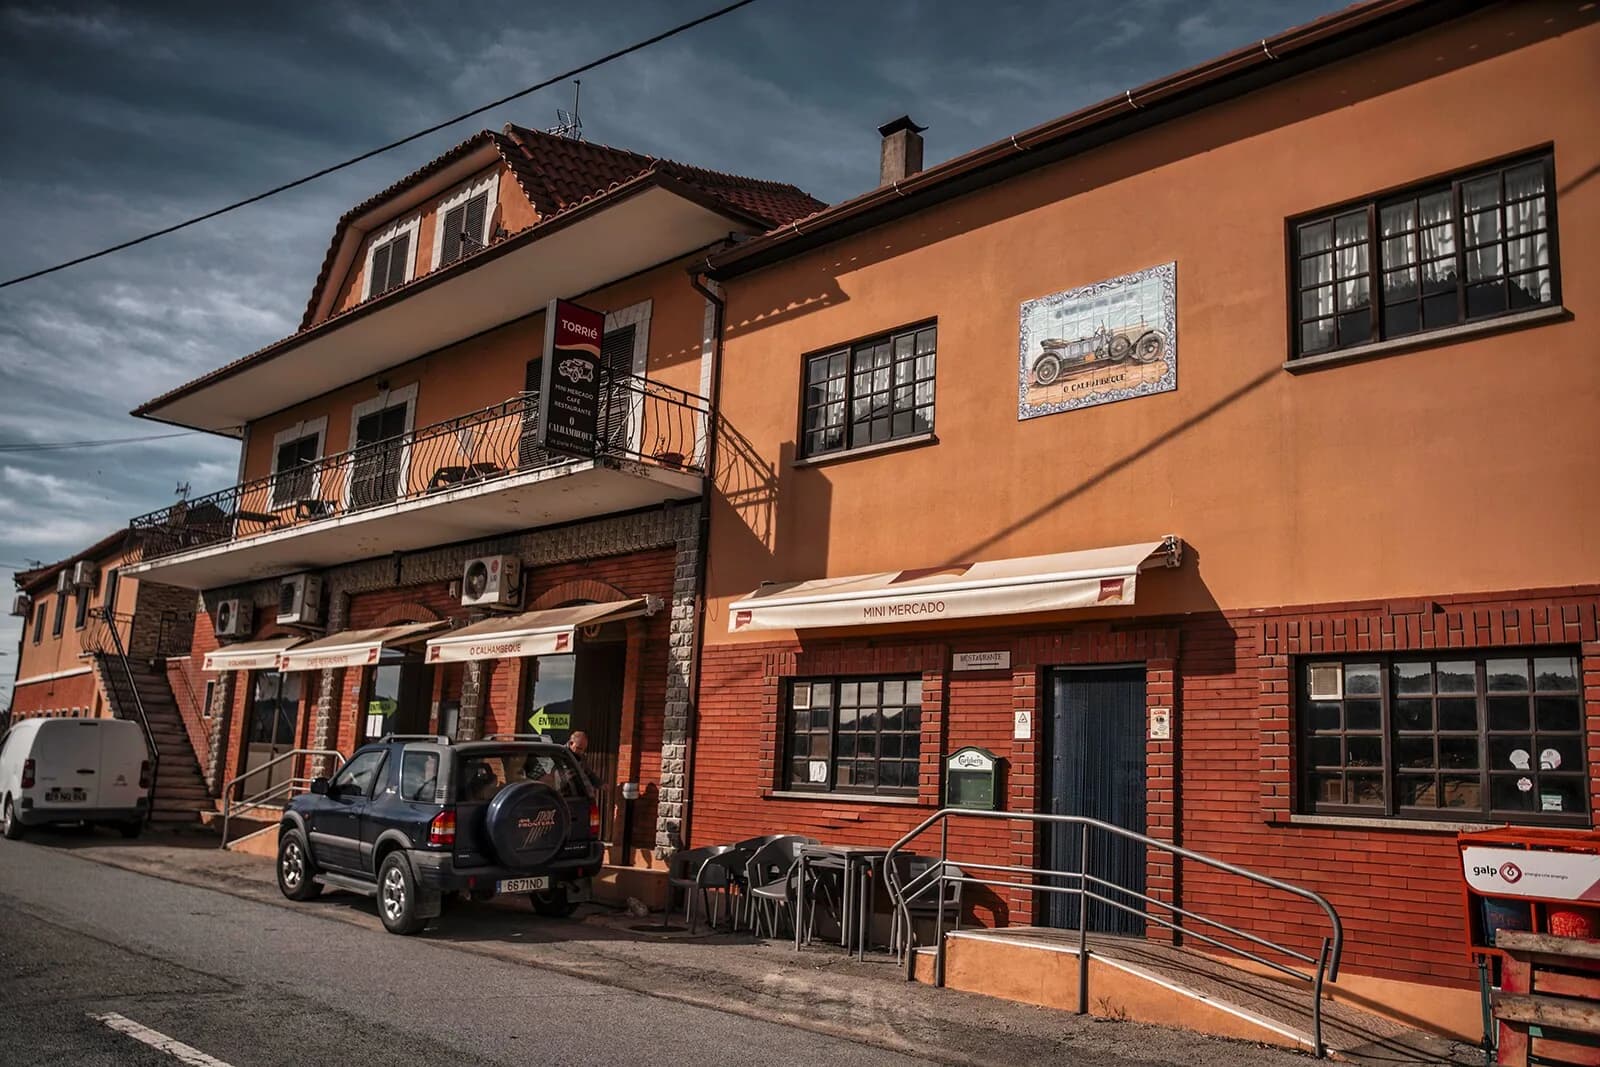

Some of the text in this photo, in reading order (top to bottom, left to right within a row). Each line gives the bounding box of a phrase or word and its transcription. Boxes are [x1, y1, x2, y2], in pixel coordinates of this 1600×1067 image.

[567, 387, 594, 400] MERCADO
[1063, 385, 1069, 393] O
[554, 400, 591, 416] RESTAURANTE
[569, 416, 575, 426] O
[863, 601, 945, 618] MINI MERCADO
[469, 643, 521, 656] O CALHAMBEQUE
[960, 653, 1001, 662] RESTAURANTE
[538, 717, 569, 726] ENTRADA
[1473, 865, 1497, 877] galp
[507, 878, 543, 890] 6671ND
